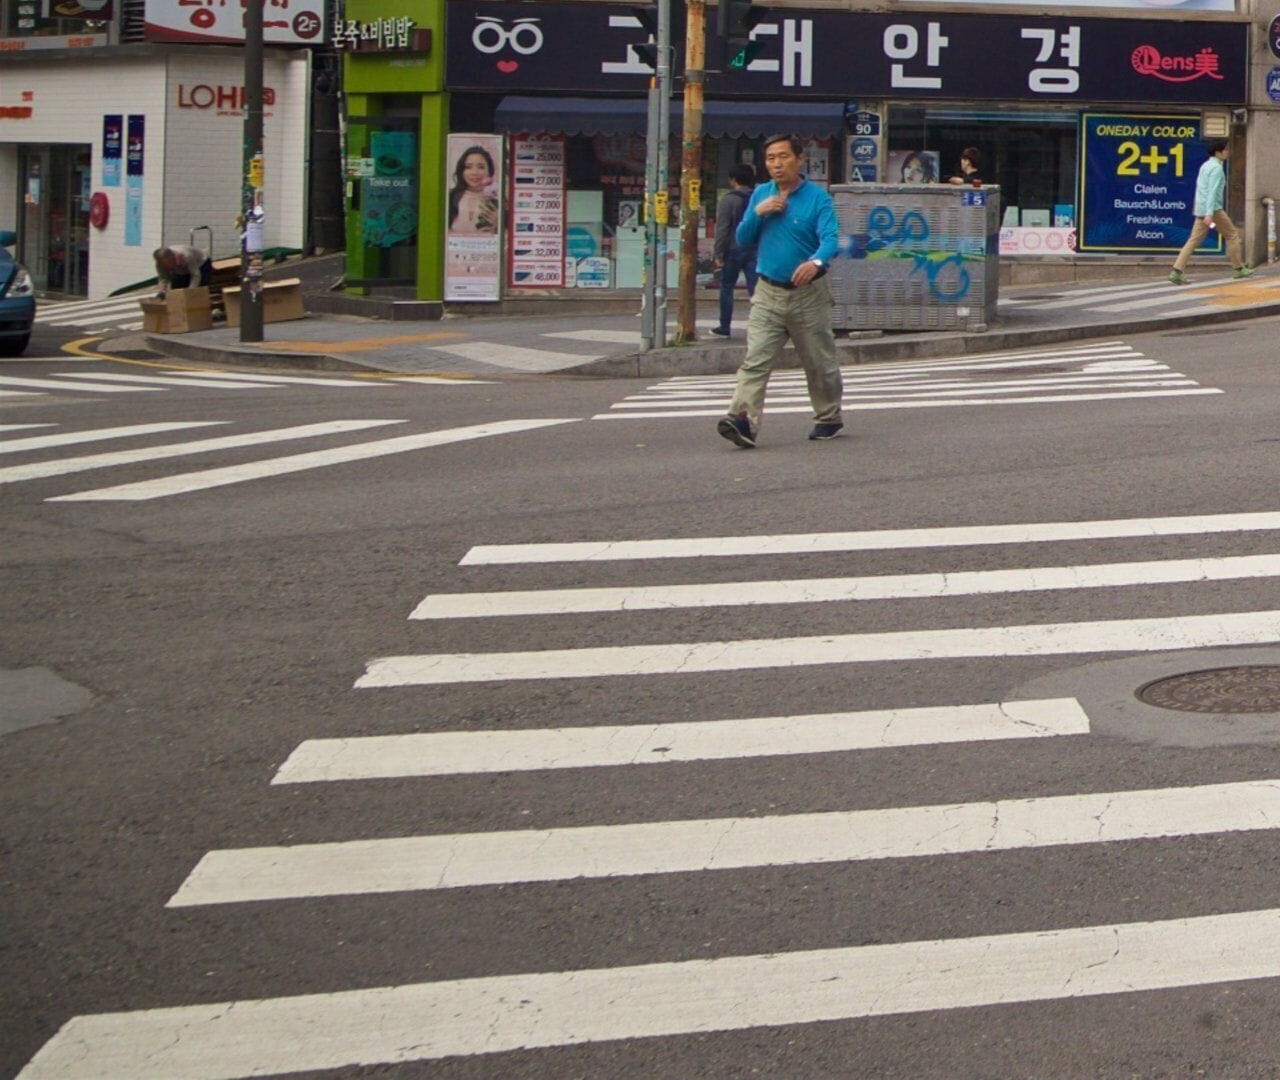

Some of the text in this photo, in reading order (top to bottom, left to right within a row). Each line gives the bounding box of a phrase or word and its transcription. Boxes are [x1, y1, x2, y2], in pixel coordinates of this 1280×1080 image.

[297, 16, 318, 32] 2F
[855, 123, 872, 135] 90
[1096, 124, 1196, 139] ONEDAY COLOR
[855, 145, 873, 155] ADT
[1116, 141, 1184, 178] 2+1
[973, 196, 982, 205] 5
[1114, 198, 1186, 211] Bausch&Lomb
[1126, 214, 1173, 225] Freshkon
[1135, 229, 1164, 240] Alcon
